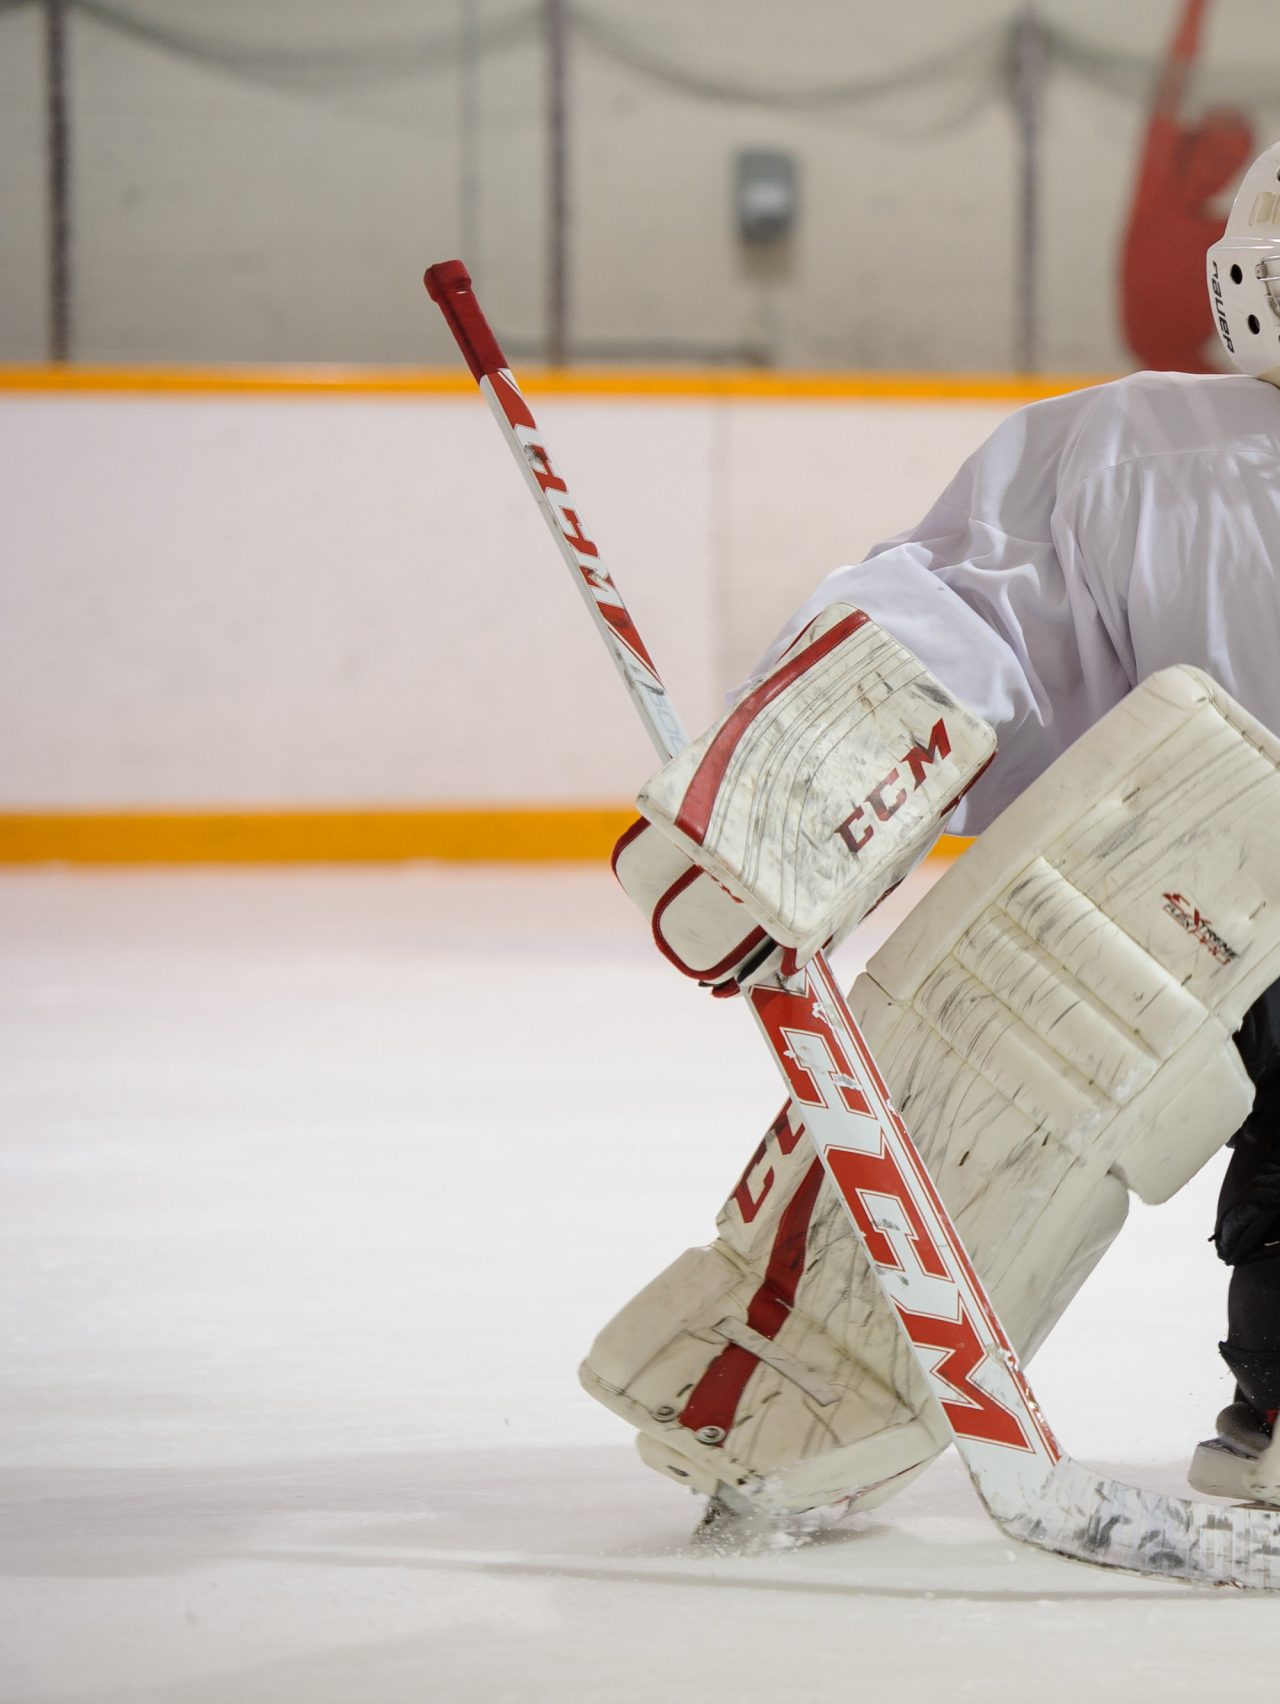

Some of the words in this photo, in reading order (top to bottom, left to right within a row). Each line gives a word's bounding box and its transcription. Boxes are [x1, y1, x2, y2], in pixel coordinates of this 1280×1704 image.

[514, 424, 624, 609] CCM
[834, 717, 952, 854] CCM
[732, 1097, 806, 1224] CC
[747, 983, 1037, 1454] CCM
